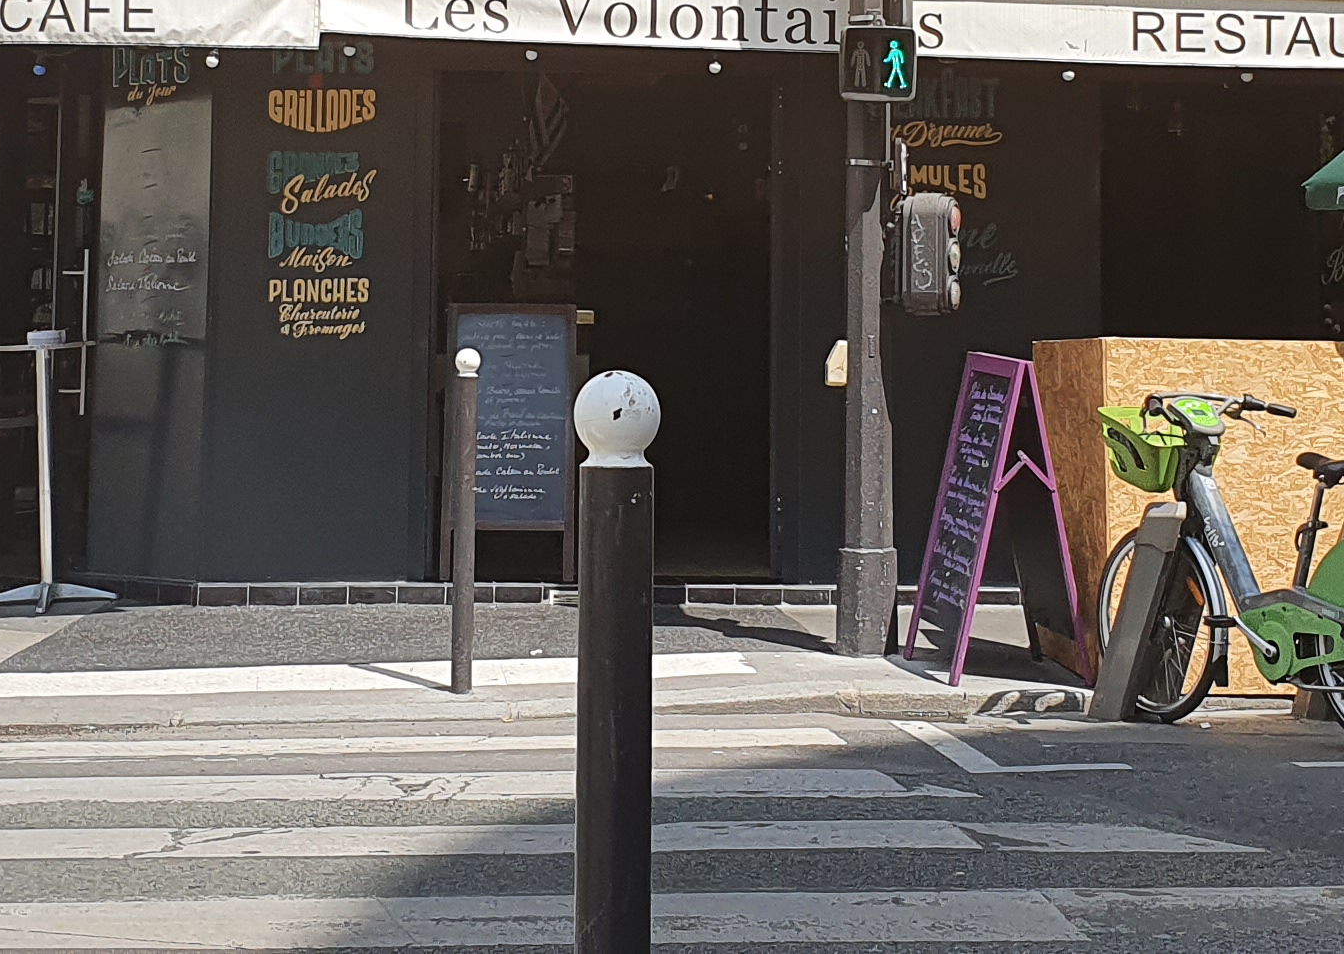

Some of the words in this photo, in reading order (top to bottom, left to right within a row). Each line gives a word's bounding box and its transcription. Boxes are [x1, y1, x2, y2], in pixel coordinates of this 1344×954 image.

[112, 46, 191, 88] PLATS
[279, 168, 378, 214] Salades
[909, 162, 987, 199] MULES
[278, 246, 353, 273] Maison
[267, 277, 370, 304] PLANCHES
[291, 320, 367, 341] Fromages
